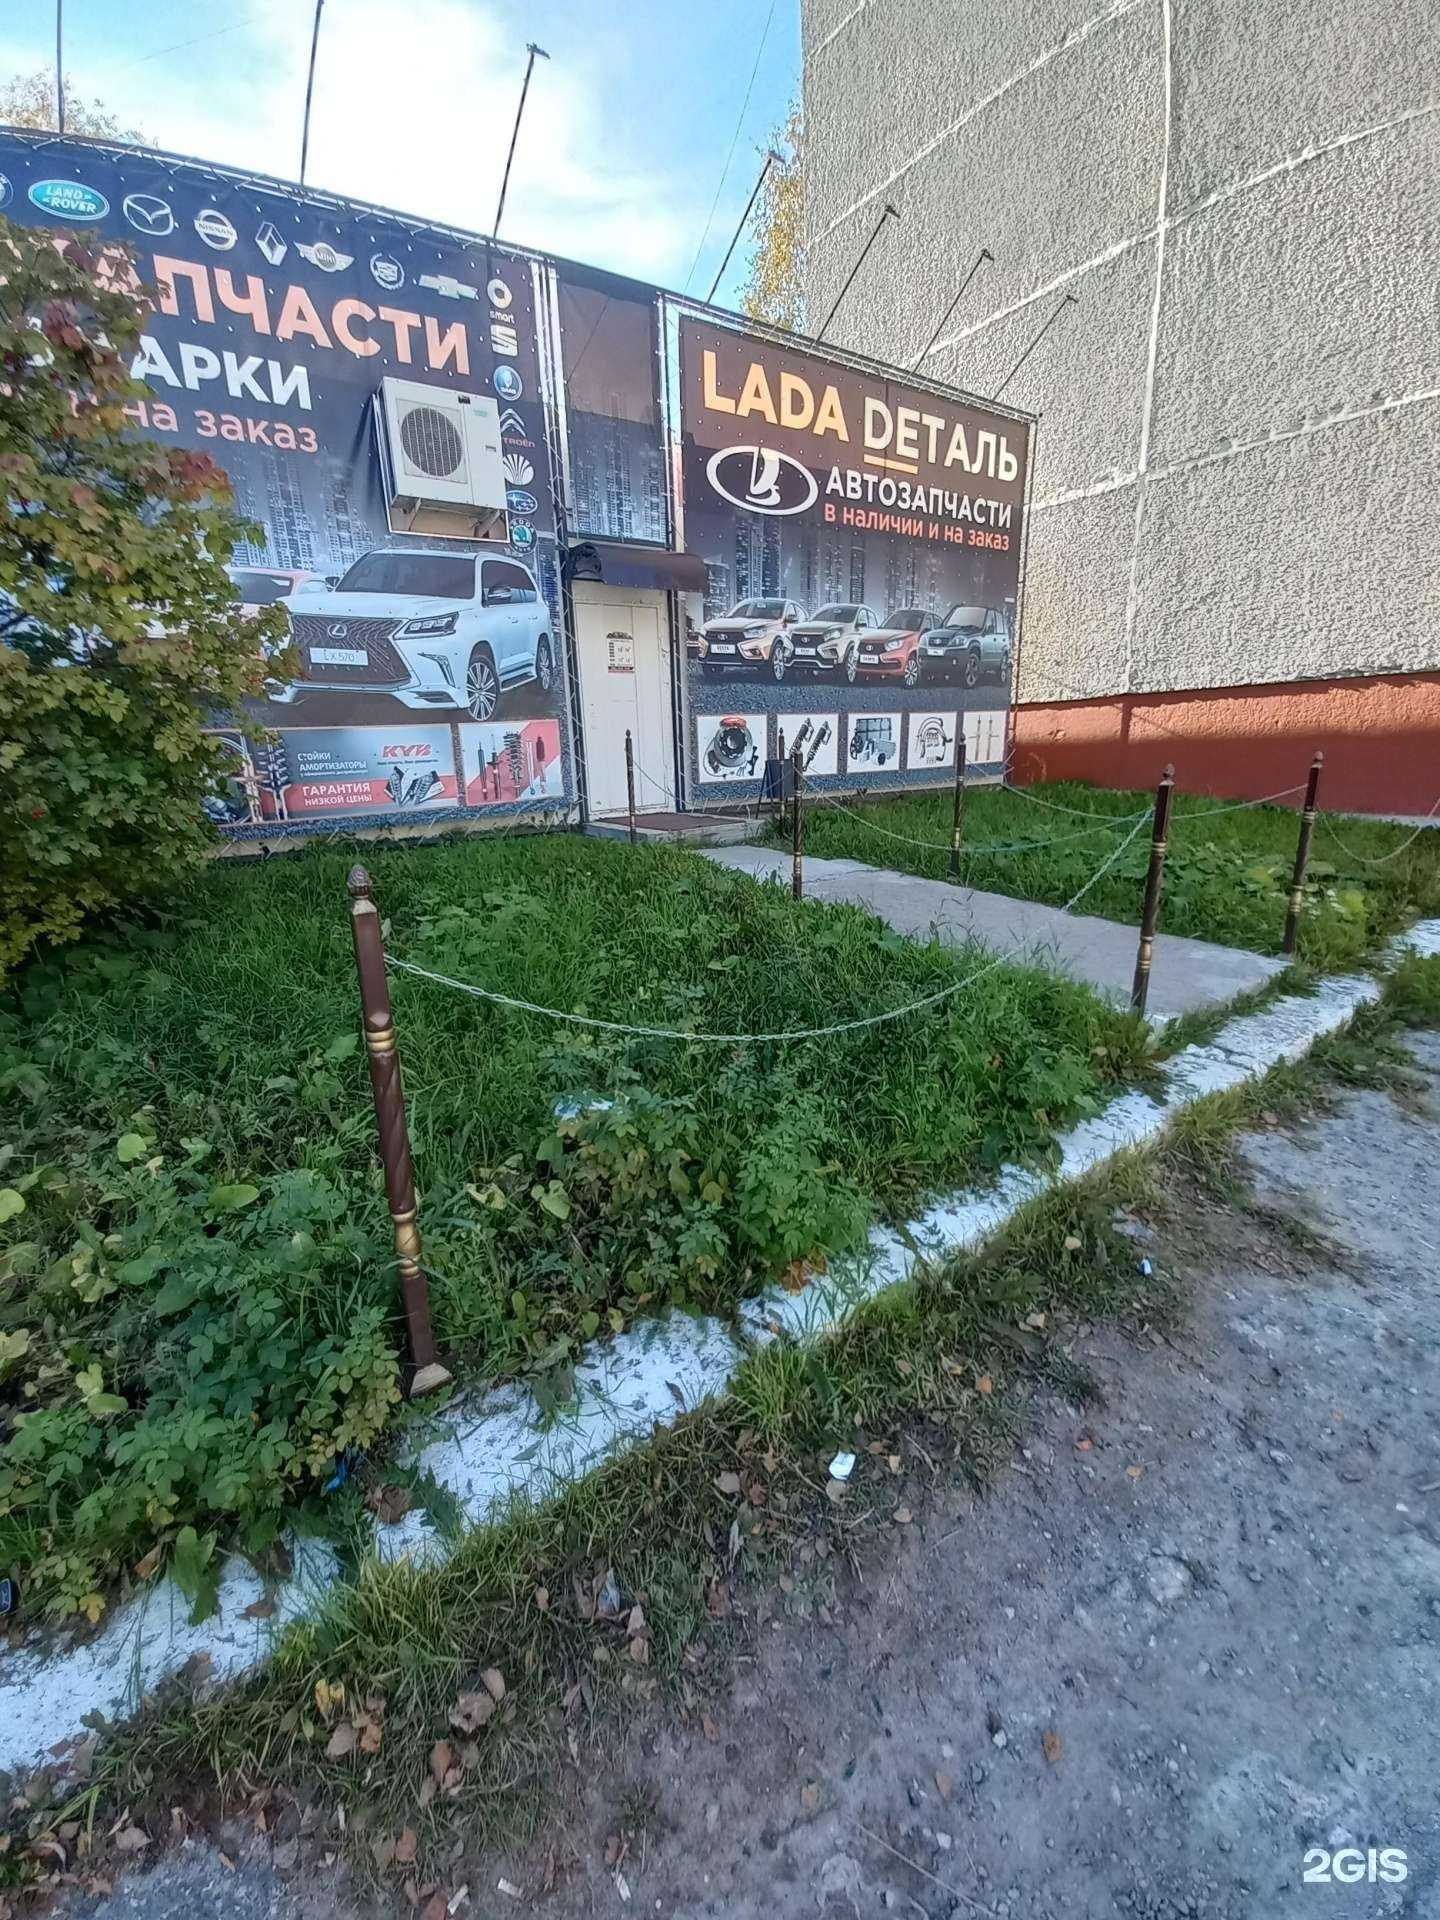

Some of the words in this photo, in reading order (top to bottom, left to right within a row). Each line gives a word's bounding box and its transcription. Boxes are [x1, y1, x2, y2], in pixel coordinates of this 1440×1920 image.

[46, 185, 83, 200] LAND
[51, 196, 96, 213] ROVER
[489, 310, 515, 324] smart
[92, 331, 313, 411] АРКИ
[703, 349, 850, 443] LADA
[194, 409, 319, 454] заказ
[825, 465, 1012, 529] АВТОЗАПЧАСТИ
[843, 506, 923, 539] наличии
[928, 522, 939, 540] и
[944, 524, 964, 544] на
[967, 529, 1010, 551] заказ
[382, 744, 433, 758] KYB
[299, 760, 367, 772] АМОРТИЗАТОРЫ
[302, 782, 371, 797] ГАРАНТИЯ
[304, 795, 344, 807] НИЗКОЙ
[346, 793, 373, 805] ЦЕНЫ
